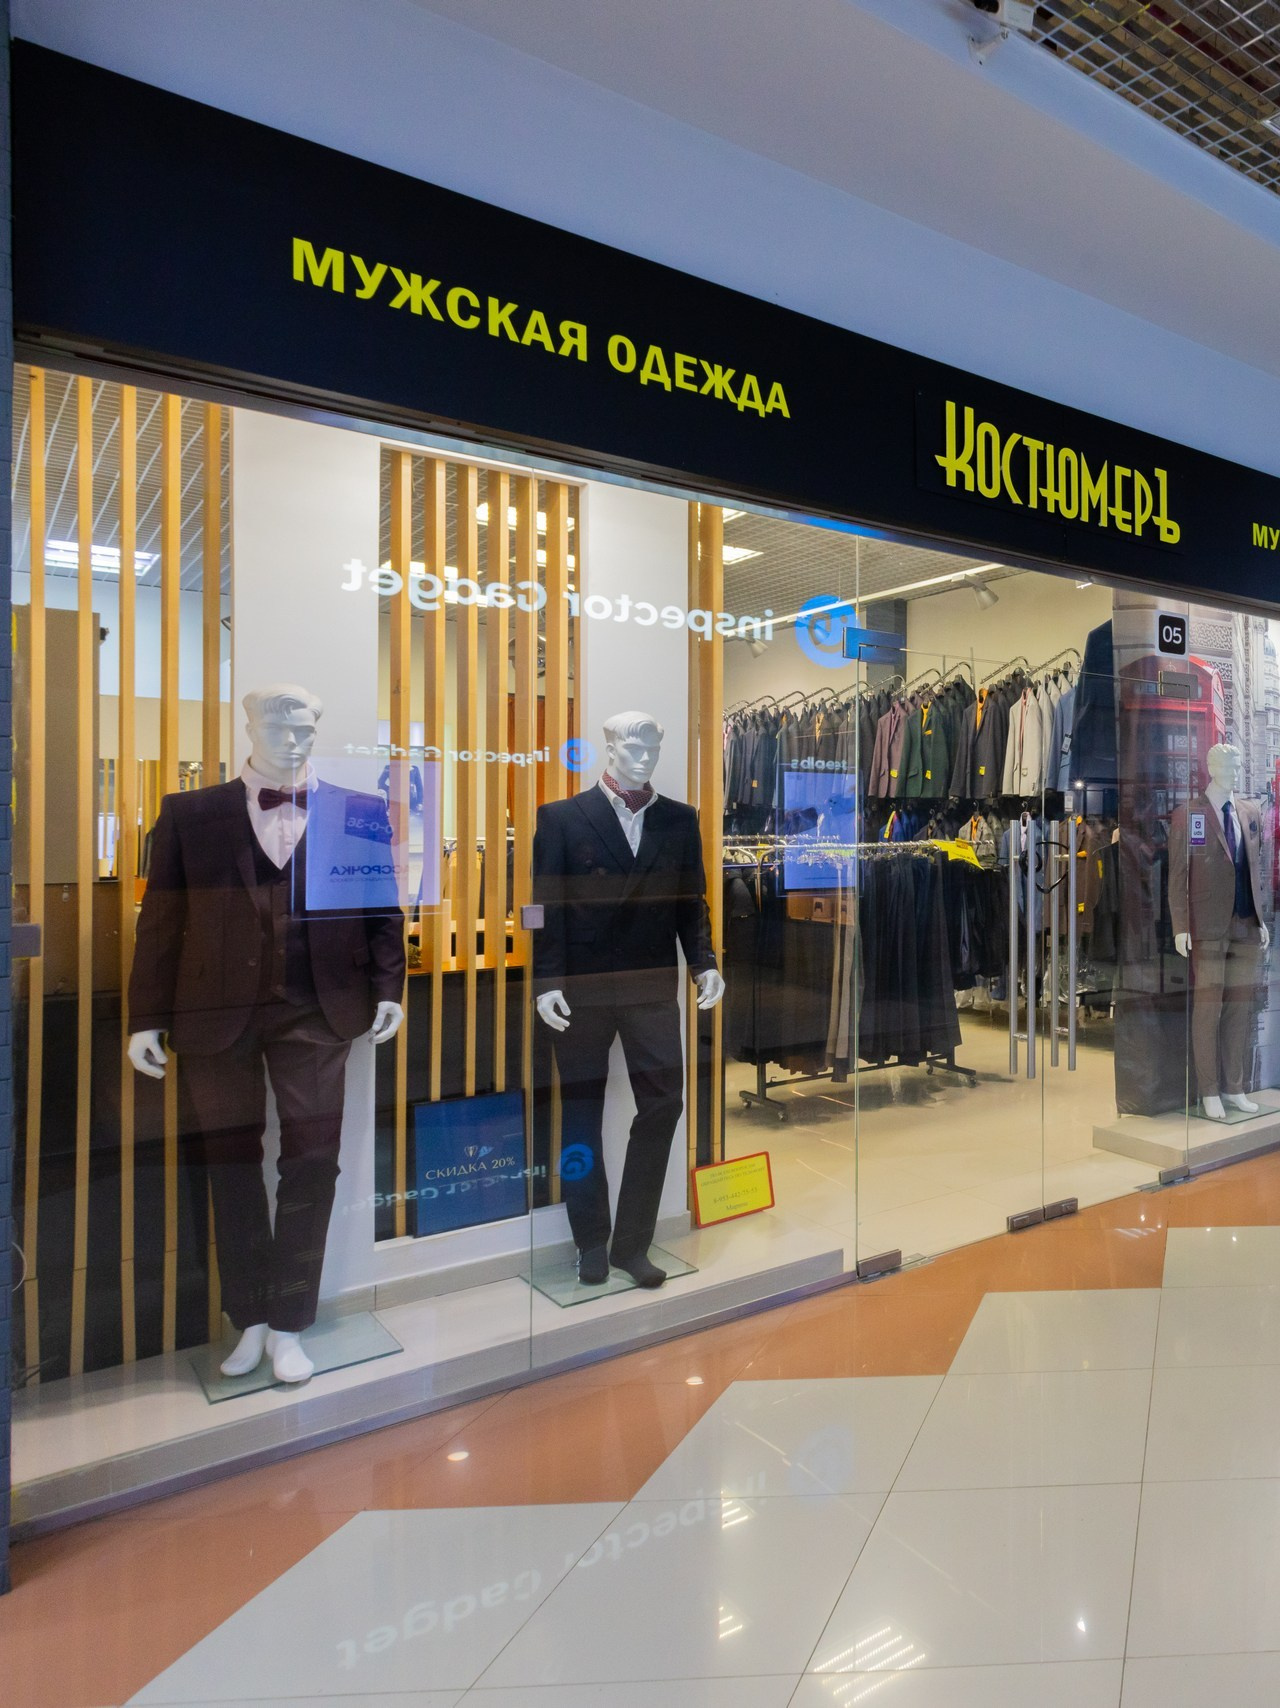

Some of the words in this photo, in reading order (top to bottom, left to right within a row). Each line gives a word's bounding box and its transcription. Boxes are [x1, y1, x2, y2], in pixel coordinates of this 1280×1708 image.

[292, 237, 588, 362] МУЖСКАЯ
[608, 334, 791, 419] ОДЕЖДА
[1162, 625, 1182, 645] 05
[425, 1160, 487, 1181] СКИДКА
[491, 1156, 516, 1170] 20%
